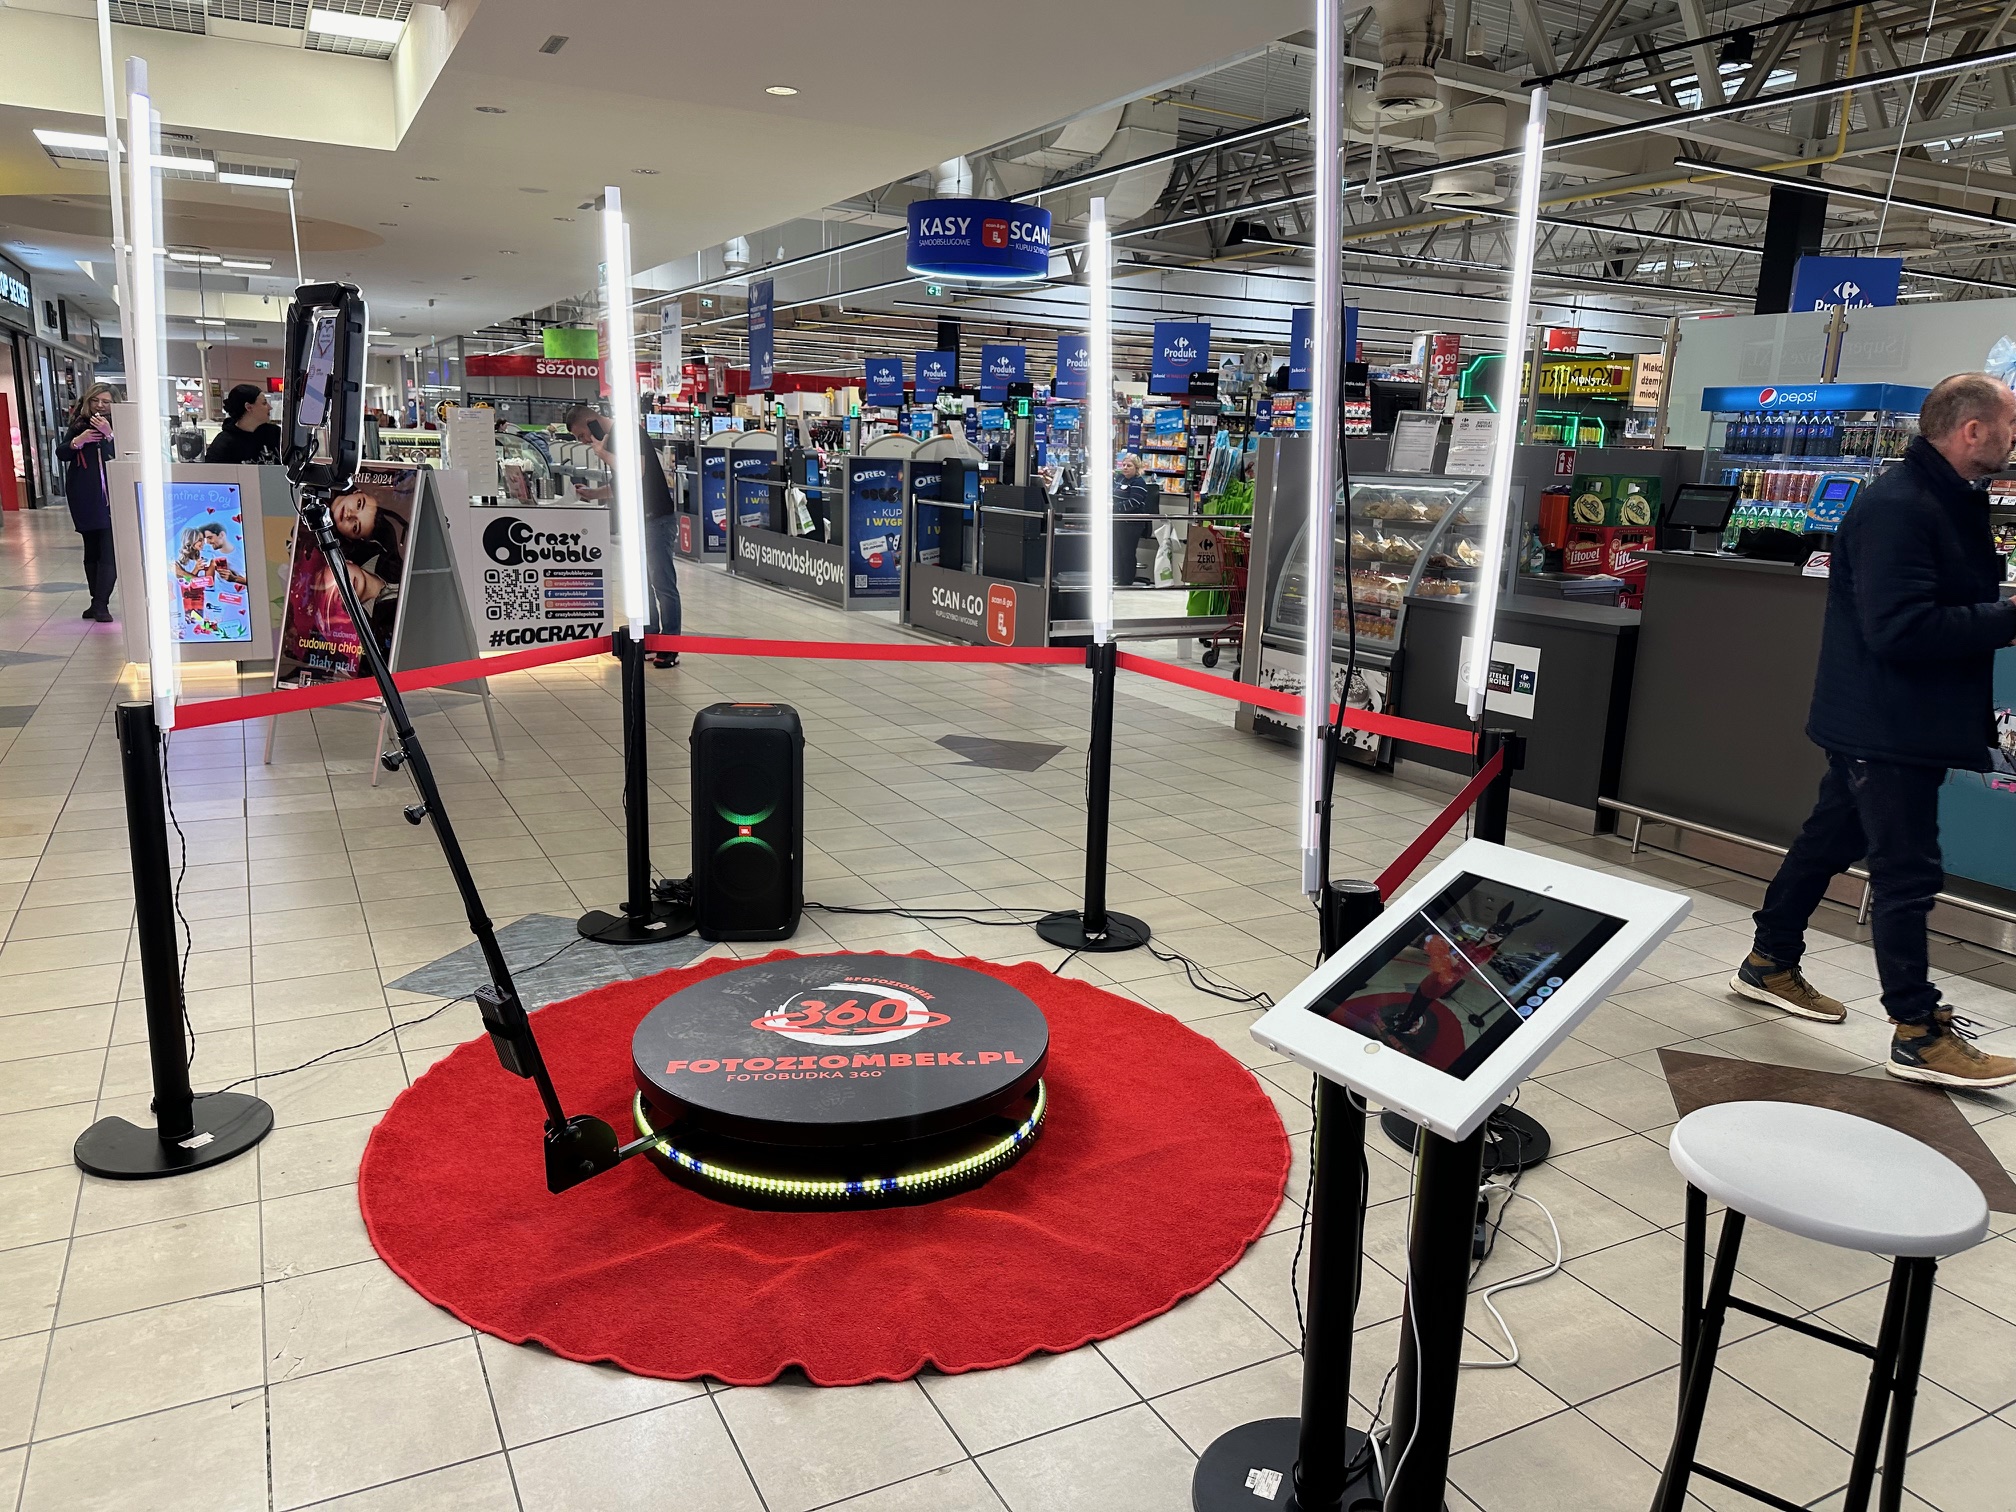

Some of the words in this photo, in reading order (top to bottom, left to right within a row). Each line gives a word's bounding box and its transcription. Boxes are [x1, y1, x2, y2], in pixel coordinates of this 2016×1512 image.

[920, 217, 971, 237] KASY
[1010, 221, 1048, 246] SCAN
[919, 238, 971, 247] SAMOOBSŁUGOWE
[1015, 243, 1032, 252] KUPUJ
[9, 276, 29, 308] SECRET
[1164, 347, 1197, 358] Produkt
[536, 363, 600, 376] sezono
[990, 364, 1015, 374] Produkt
[1435, 354, 1445, 373] 8
[1444, 353, 1457, 364] 99
[873, 374, 895, 383] Produkt
[923, 369, 947, 378] Produkt
[1639, 389, 1660, 401] miody
[1778, 389, 1817, 405] pepsi
[734, 459, 762, 469] OREO
[372, 473, 394, 484] 2024
[853, 470, 886, 483] OREO
[915, 475, 941, 488] ORE
[208, 490, 231, 508] Day
[510, 522, 582, 546] Crazy
[522, 544, 602, 563] bubble
[738, 535, 761, 567] Kasy
[761, 547, 844, 586] samoobsługowe
[1197, 554, 1216, 564] ZERO
[1570, 547, 1600, 565] Litovel
[932, 586, 960, 611] SCAN
[961, 598, 967, 609] &
[966, 594, 984, 616] GO
[991, 596, 1002, 605] scan
[1006, 599, 1013, 609] go
[489, 622, 603, 647] #GOCRAZY
[298, 637, 337, 655] cudowny
[309, 653, 334, 673] Biały
[335, 658, 358, 674] ptak
[843, 976, 937, 1001] #FOTOZIOMBEK
[665, 1050, 1024, 1075] FOTOZIOMBEK.PL
[726, 1070, 844, 1082] FOTOBUDKA
